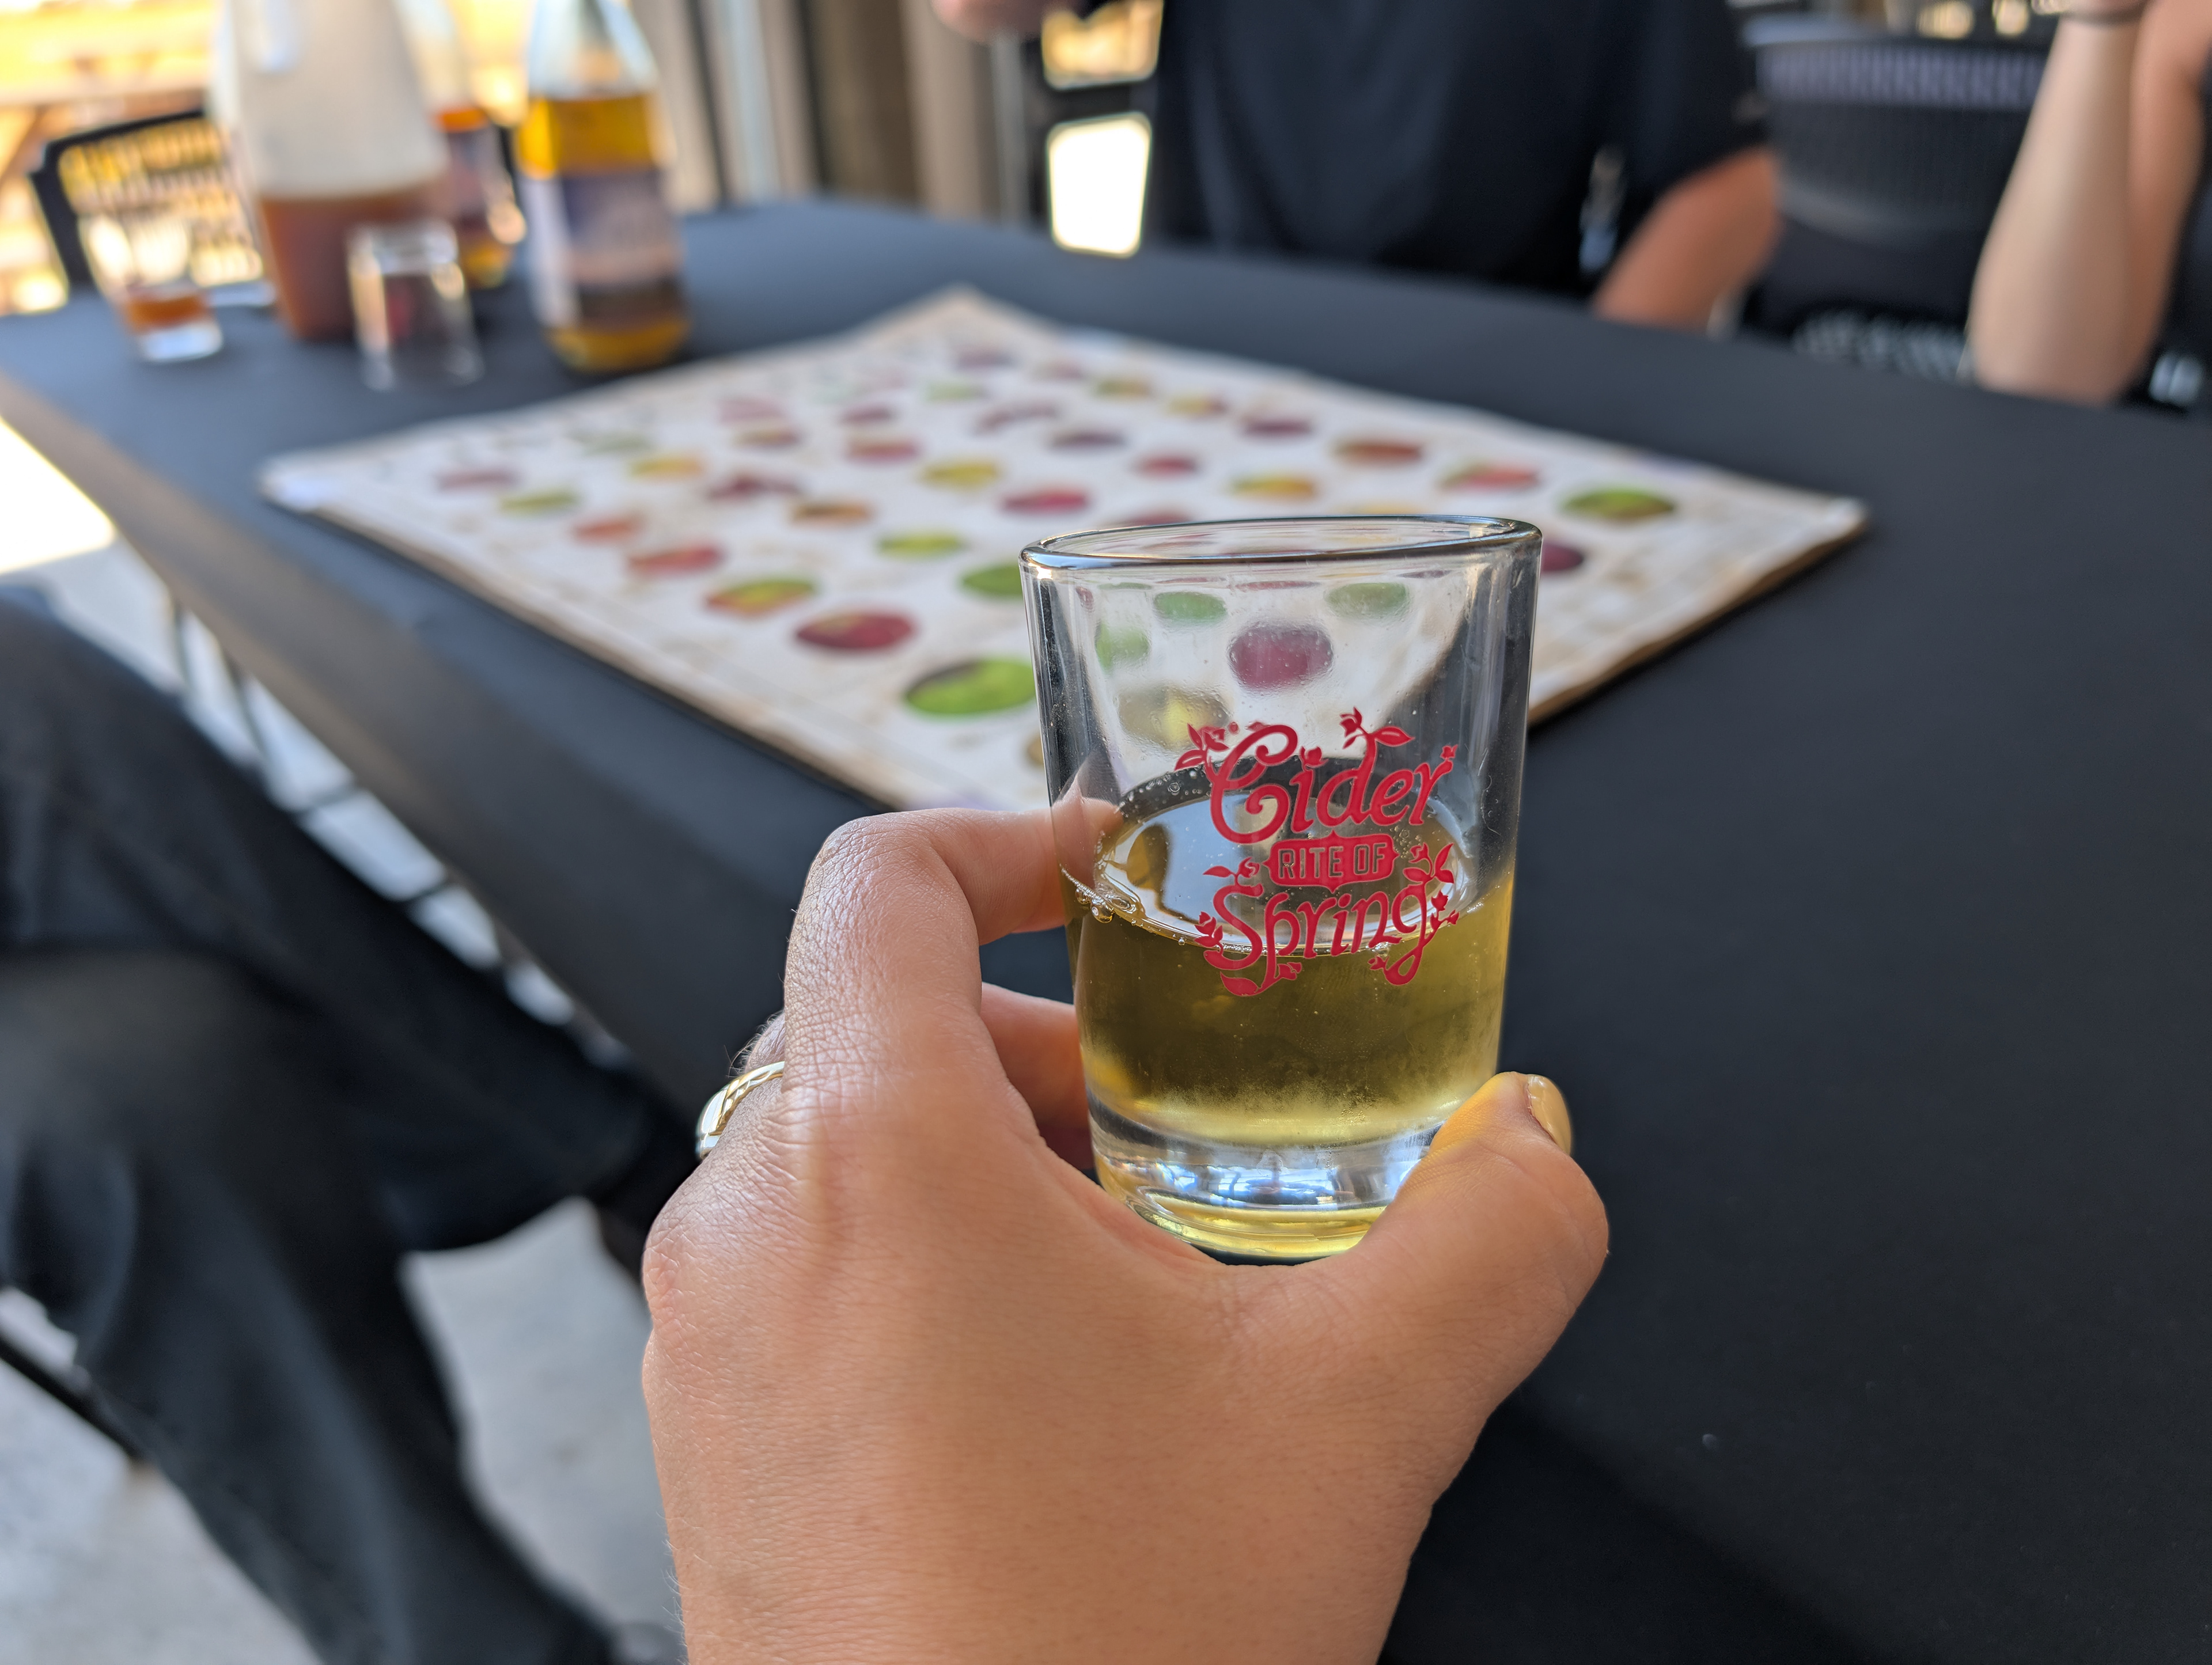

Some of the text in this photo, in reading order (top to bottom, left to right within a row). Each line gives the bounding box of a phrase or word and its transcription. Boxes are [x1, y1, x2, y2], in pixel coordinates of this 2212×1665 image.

[1210, 723, 1454, 844] Cider
[1278, 843, 1386, 880] RITE OF
[1203, 883, 1429, 987] Spring
